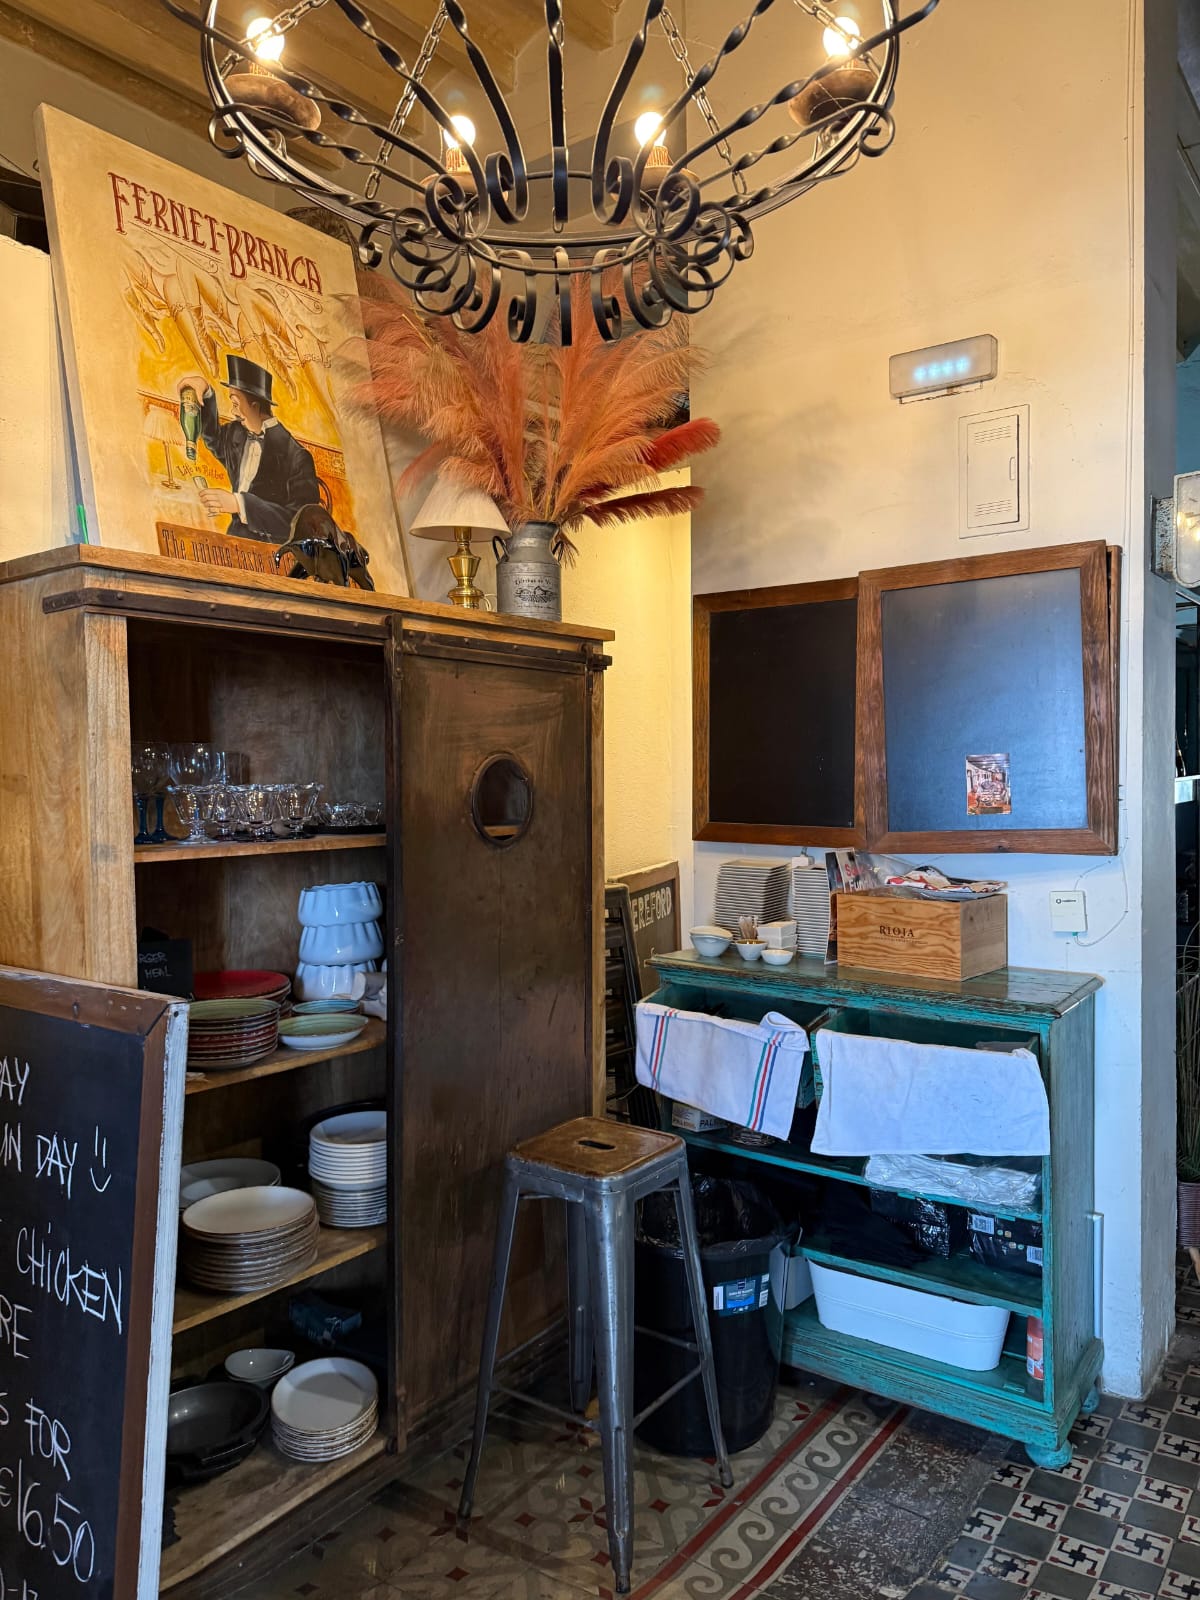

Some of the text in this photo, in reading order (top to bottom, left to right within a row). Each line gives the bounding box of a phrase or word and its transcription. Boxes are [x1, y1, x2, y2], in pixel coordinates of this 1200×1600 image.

[107, 172, 323, 295] FERNET-BRANCA
[161, 528, 187, 560] The
[235, 543, 266, 573] taste
[630, 886, 672, 933] EREFORD
[879, 925, 915, 938] RIOJA
[0, 1055, 30, 1106] AY
[36, 1131, 78, 1200] DAY
[16, 1222, 122, 1335] CHICKEN
[24, 1397, 71, 1481] FOR
